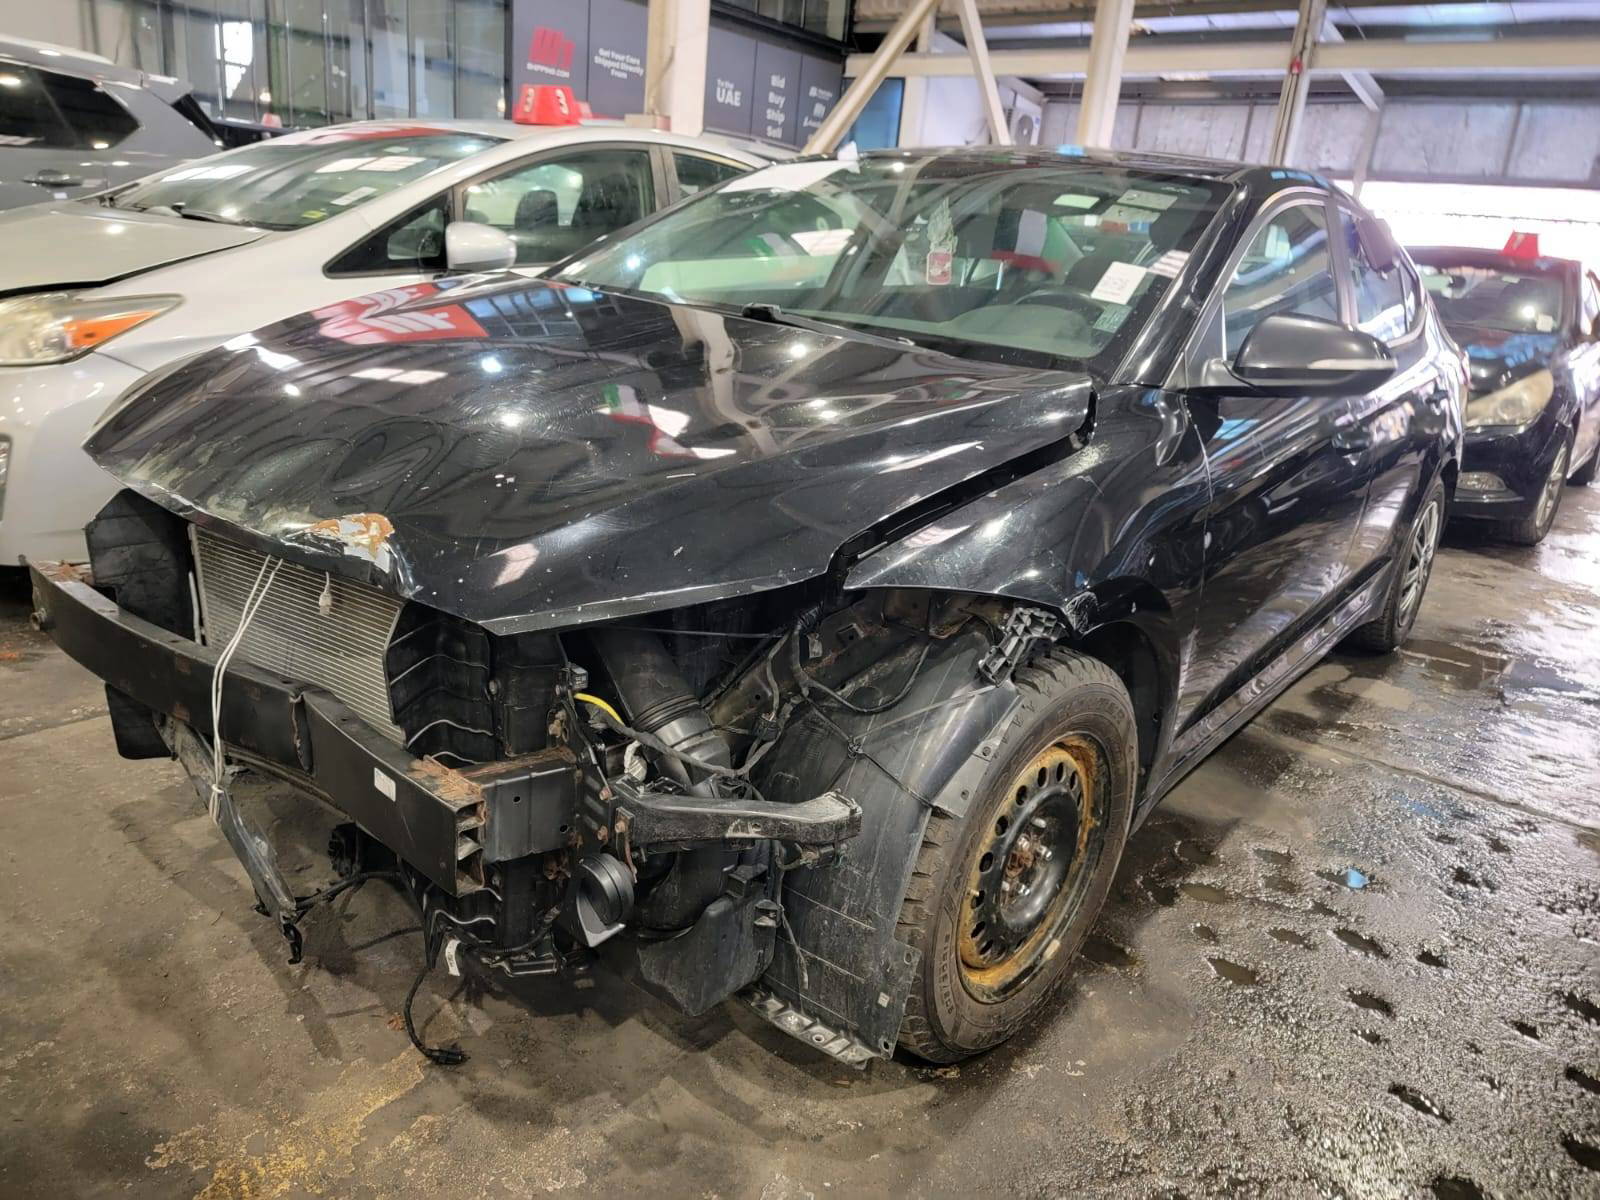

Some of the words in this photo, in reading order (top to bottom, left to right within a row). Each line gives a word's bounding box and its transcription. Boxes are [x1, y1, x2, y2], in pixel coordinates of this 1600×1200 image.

[611, 50, 626, 62] Your
[594, 55, 620, 69] Shipped
[620, 61, 644, 77] Directly
[771, 75, 786, 89] Bid
[523, 87, 535, 113] 3
[555, 88, 570, 116] 3
[716, 87, 742, 107] UAE
[768, 91, 786, 109] Buy
[766, 108, 786, 126] Ship
[766, 126, 783, 139] Sell
